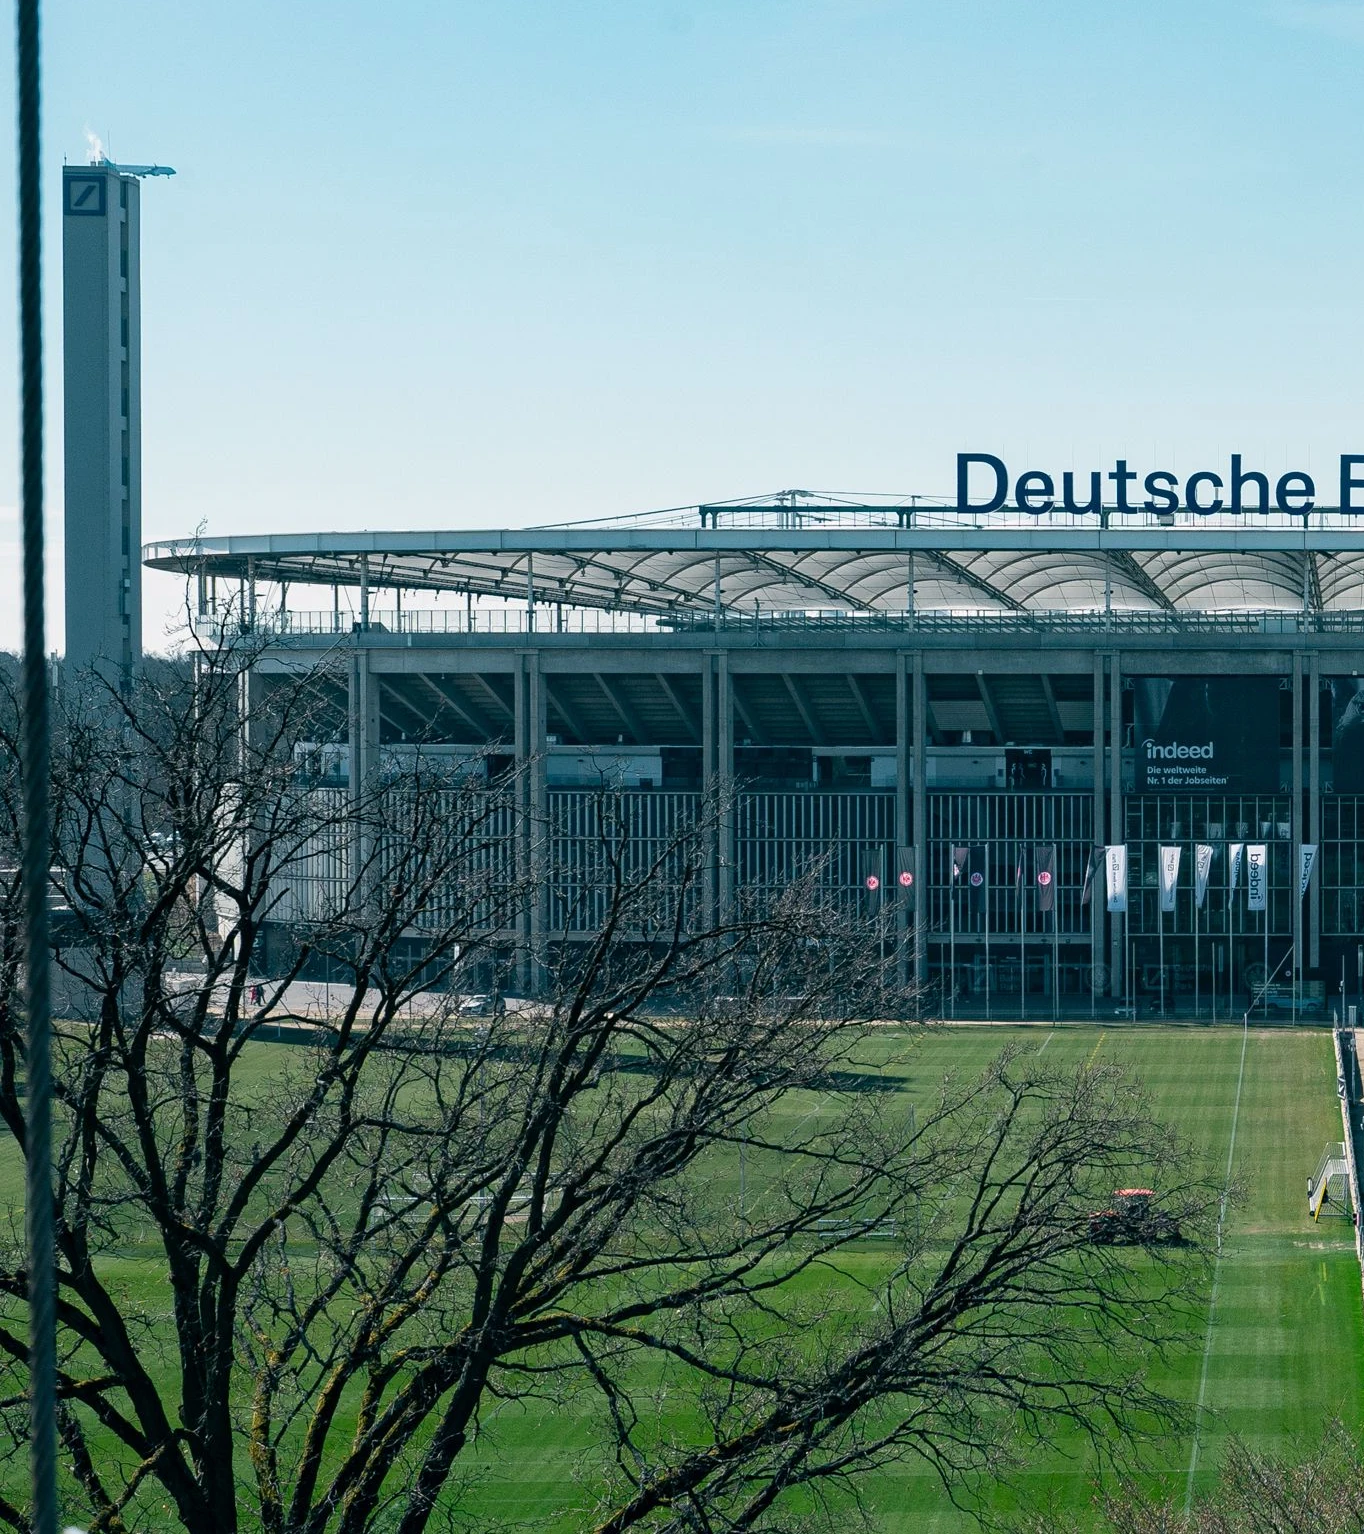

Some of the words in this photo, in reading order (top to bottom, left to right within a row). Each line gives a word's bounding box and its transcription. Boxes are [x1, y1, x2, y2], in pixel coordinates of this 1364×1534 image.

[956, 452, 1315, 515] Deutsche
[1144, 739, 1214, 759] indeed
[1147, 766, 1161, 774] Die
[1163, 766, 1207, 774] weltweite
[1147, 777, 1159, 785] Nr.
[1161, 777, 1165, 785] 1
[1168, 777, 1182, 785] der
